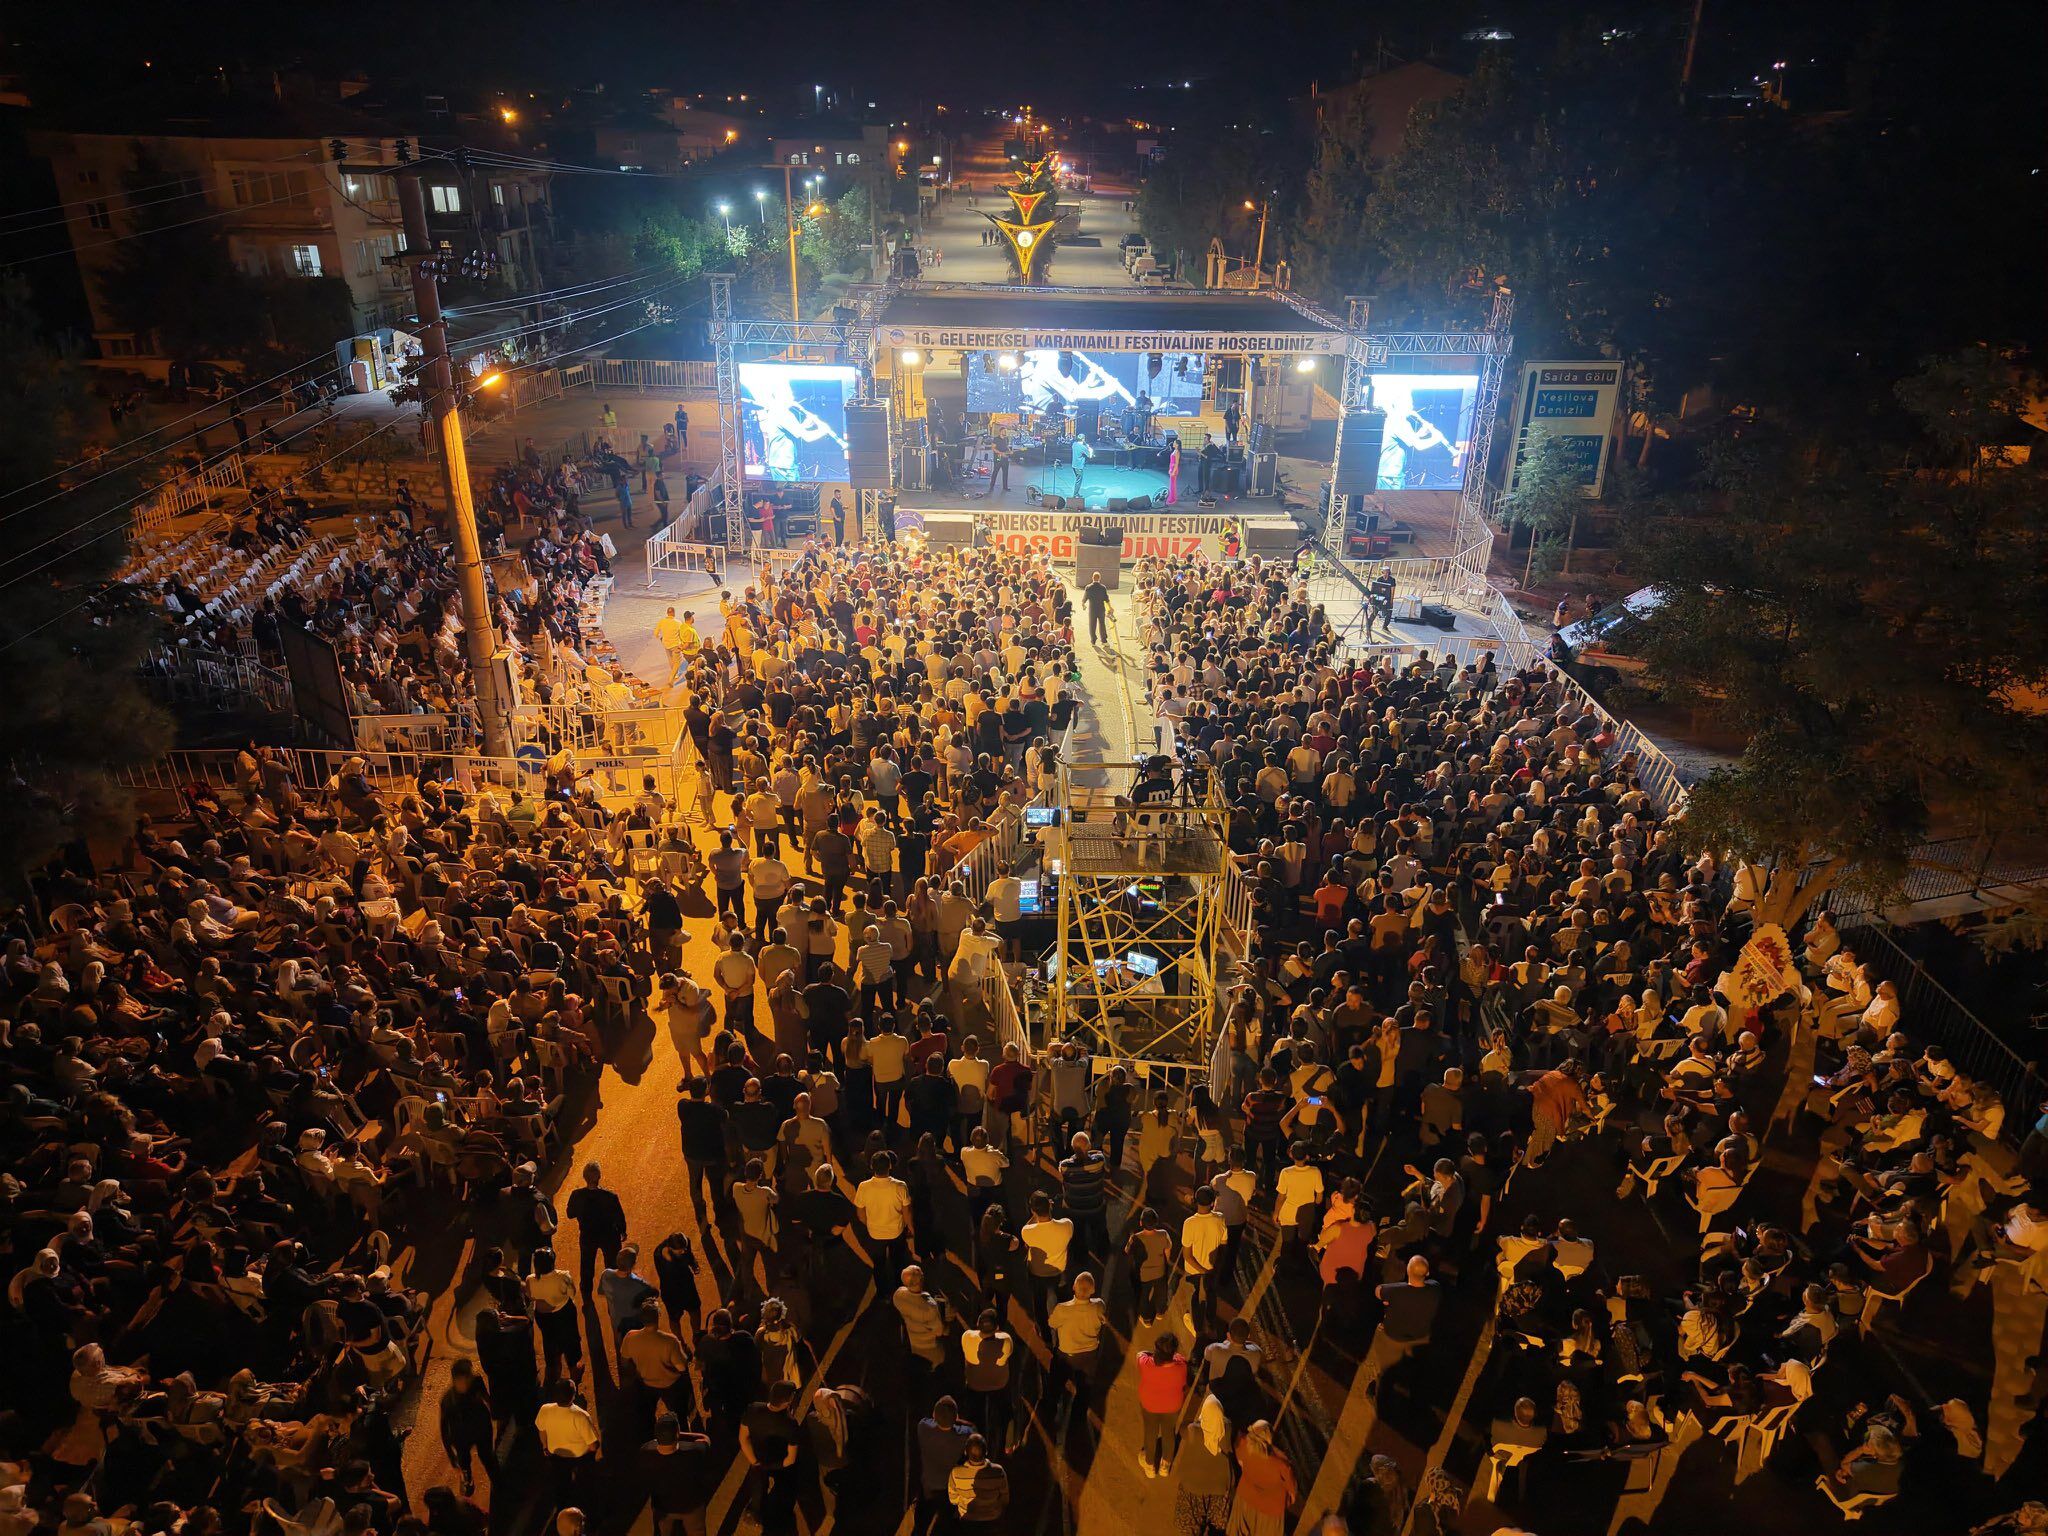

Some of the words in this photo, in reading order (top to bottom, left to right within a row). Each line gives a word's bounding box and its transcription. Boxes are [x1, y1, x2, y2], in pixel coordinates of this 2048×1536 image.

[913, 332, 935, 346] 16.
[940, 332, 1030, 348] GELENEKSEL
[1034, 334, 1119, 350] KARAMANLI
[1125, 333, 1214, 351] FESTİVALİNE
[1218, 335, 1314, 351] HOŞGELDİNİZ
[1544, 372, 1578, 381] Salda
[1585, 372, 1614, 381] Gölü
[1542, 392, 1594, 402] Yeşilova
[1538, 405, 1583, 414] Denizli
[1063, 516, 1153, 533] KARAMANLI
[469, 759, 498, 767] POLİS
[595, 759, 624, 768] POLİS
